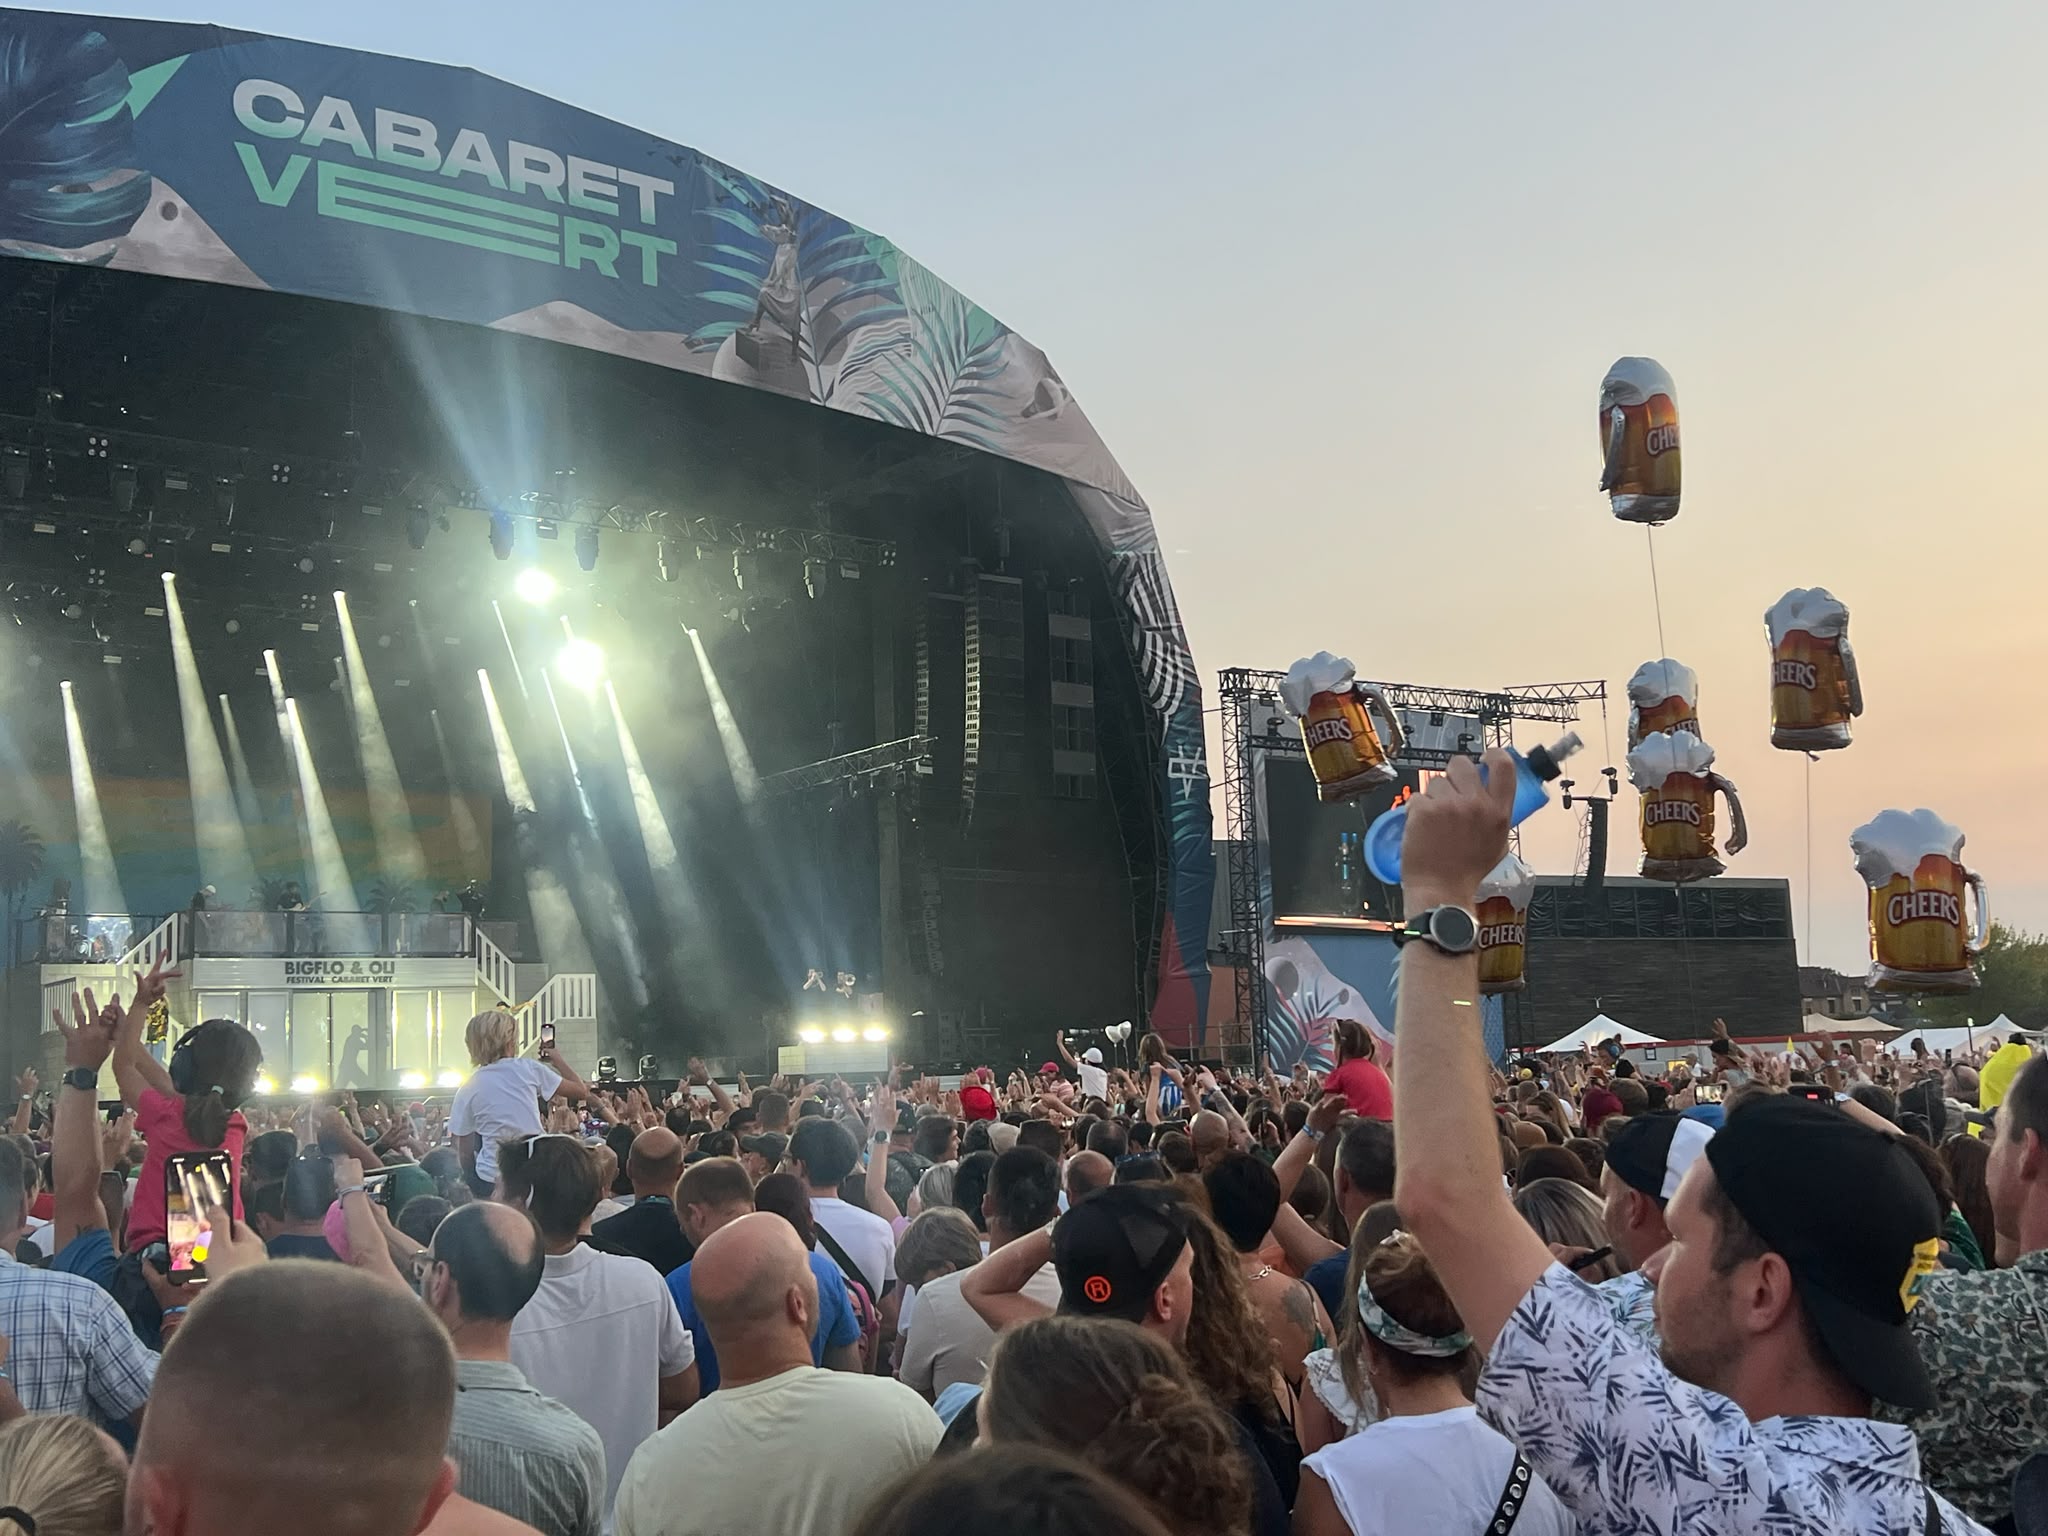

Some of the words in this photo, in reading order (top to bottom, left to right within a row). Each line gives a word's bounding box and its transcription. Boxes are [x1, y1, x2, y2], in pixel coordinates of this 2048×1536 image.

[233, 79, 674, 225] CABARET
[1772, 661, 1816, 690] HEERS
[1305, 718, 1352, 748] HEERS
[1646, 801, 1700, 825] CHEERS
[1888, 891, 1959, 925] CHEERS
[285, 961, 344, 975] BIGFLO
[350, 961, 363, 974] &
[369, 961, 395, 974] OLI
[286, 976, 325, 984] FESTIVAL
[372, 976, 393, 984] VERT
